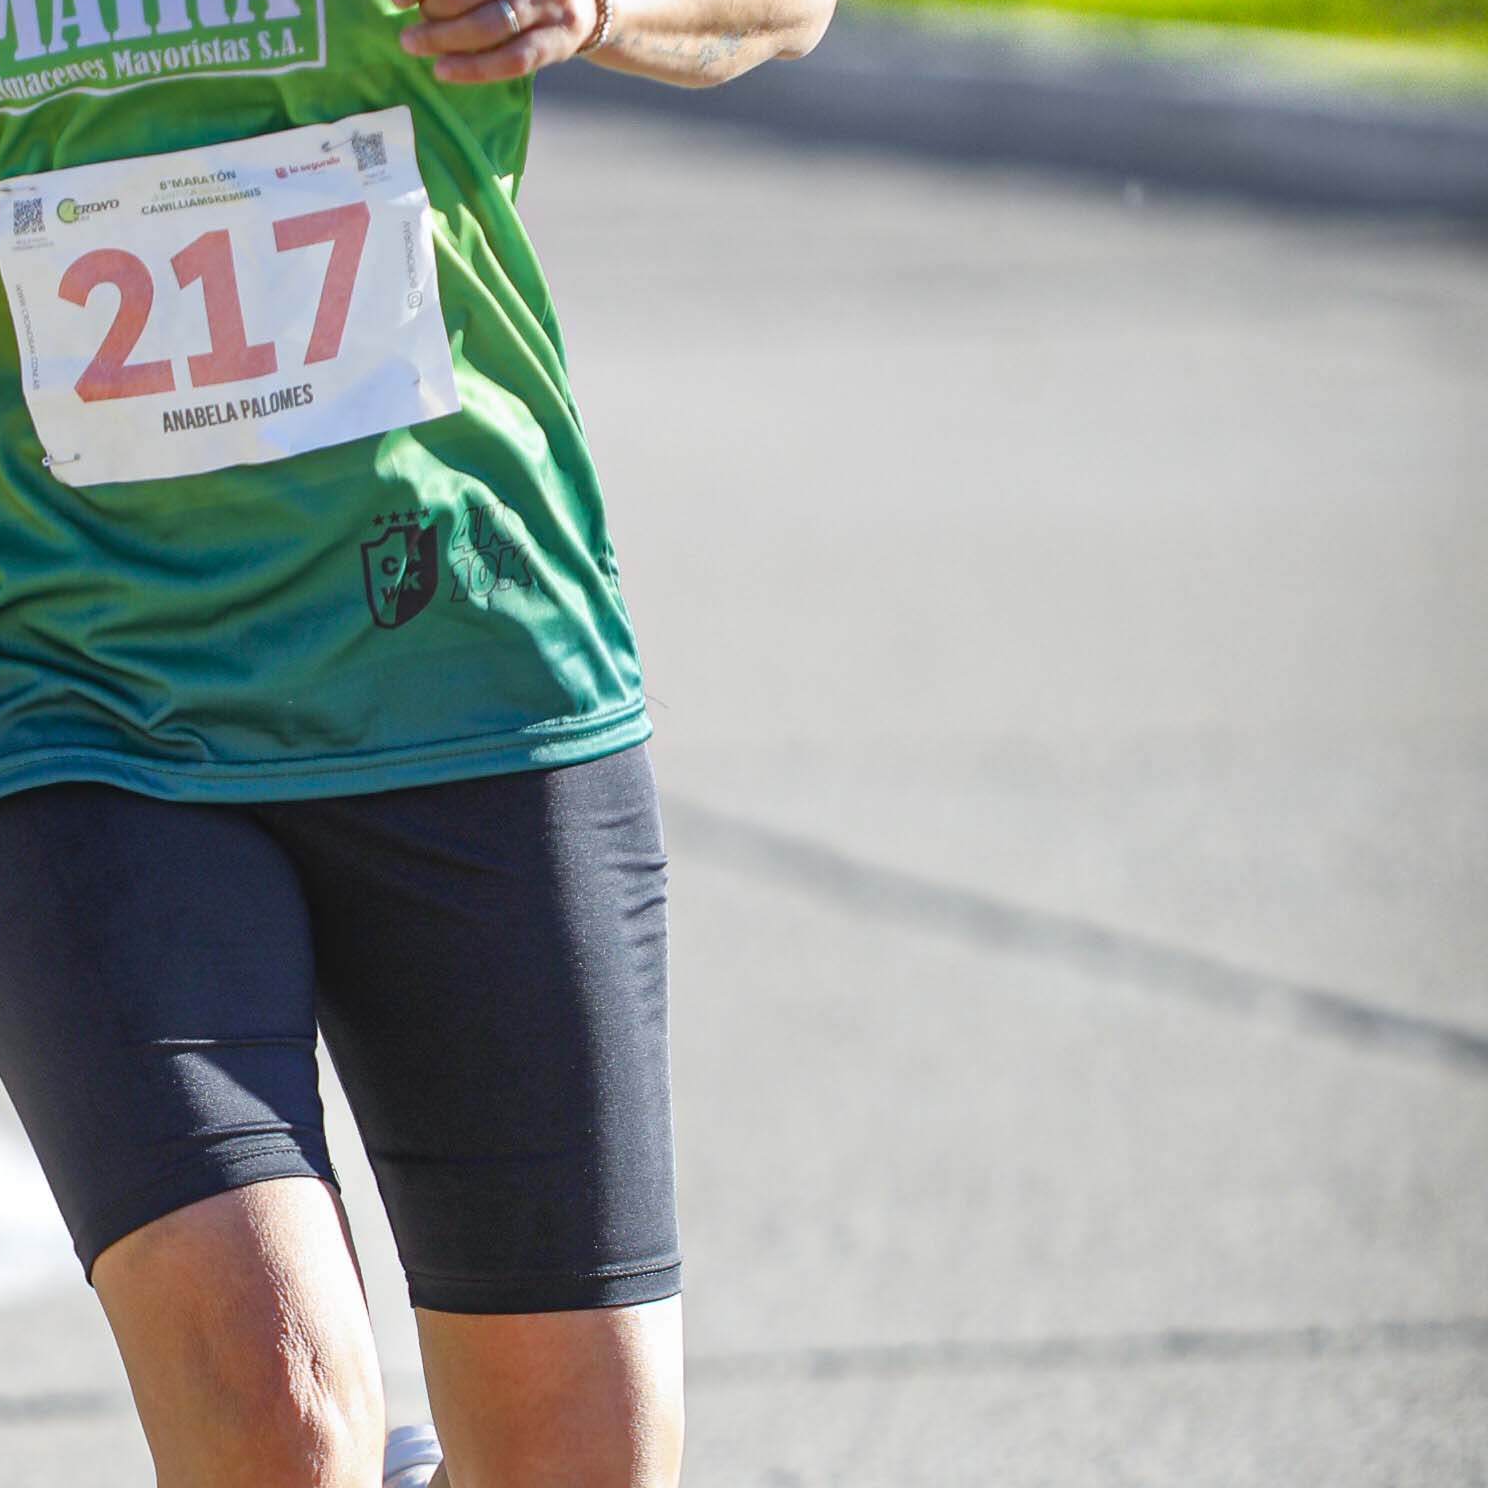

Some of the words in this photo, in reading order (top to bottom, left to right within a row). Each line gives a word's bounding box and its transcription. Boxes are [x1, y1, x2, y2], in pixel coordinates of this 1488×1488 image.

[113, 33, 251, 79] Mayoristas
[259, 27, 305, 60] S.A.
[140, 186, 262, 216] CAWILLIAMSKEMMIS
[58, 201, 371, 403] 217
[162, 401, 238, 434] ANABELA
[240, 383, 315, 420] PALOMES
